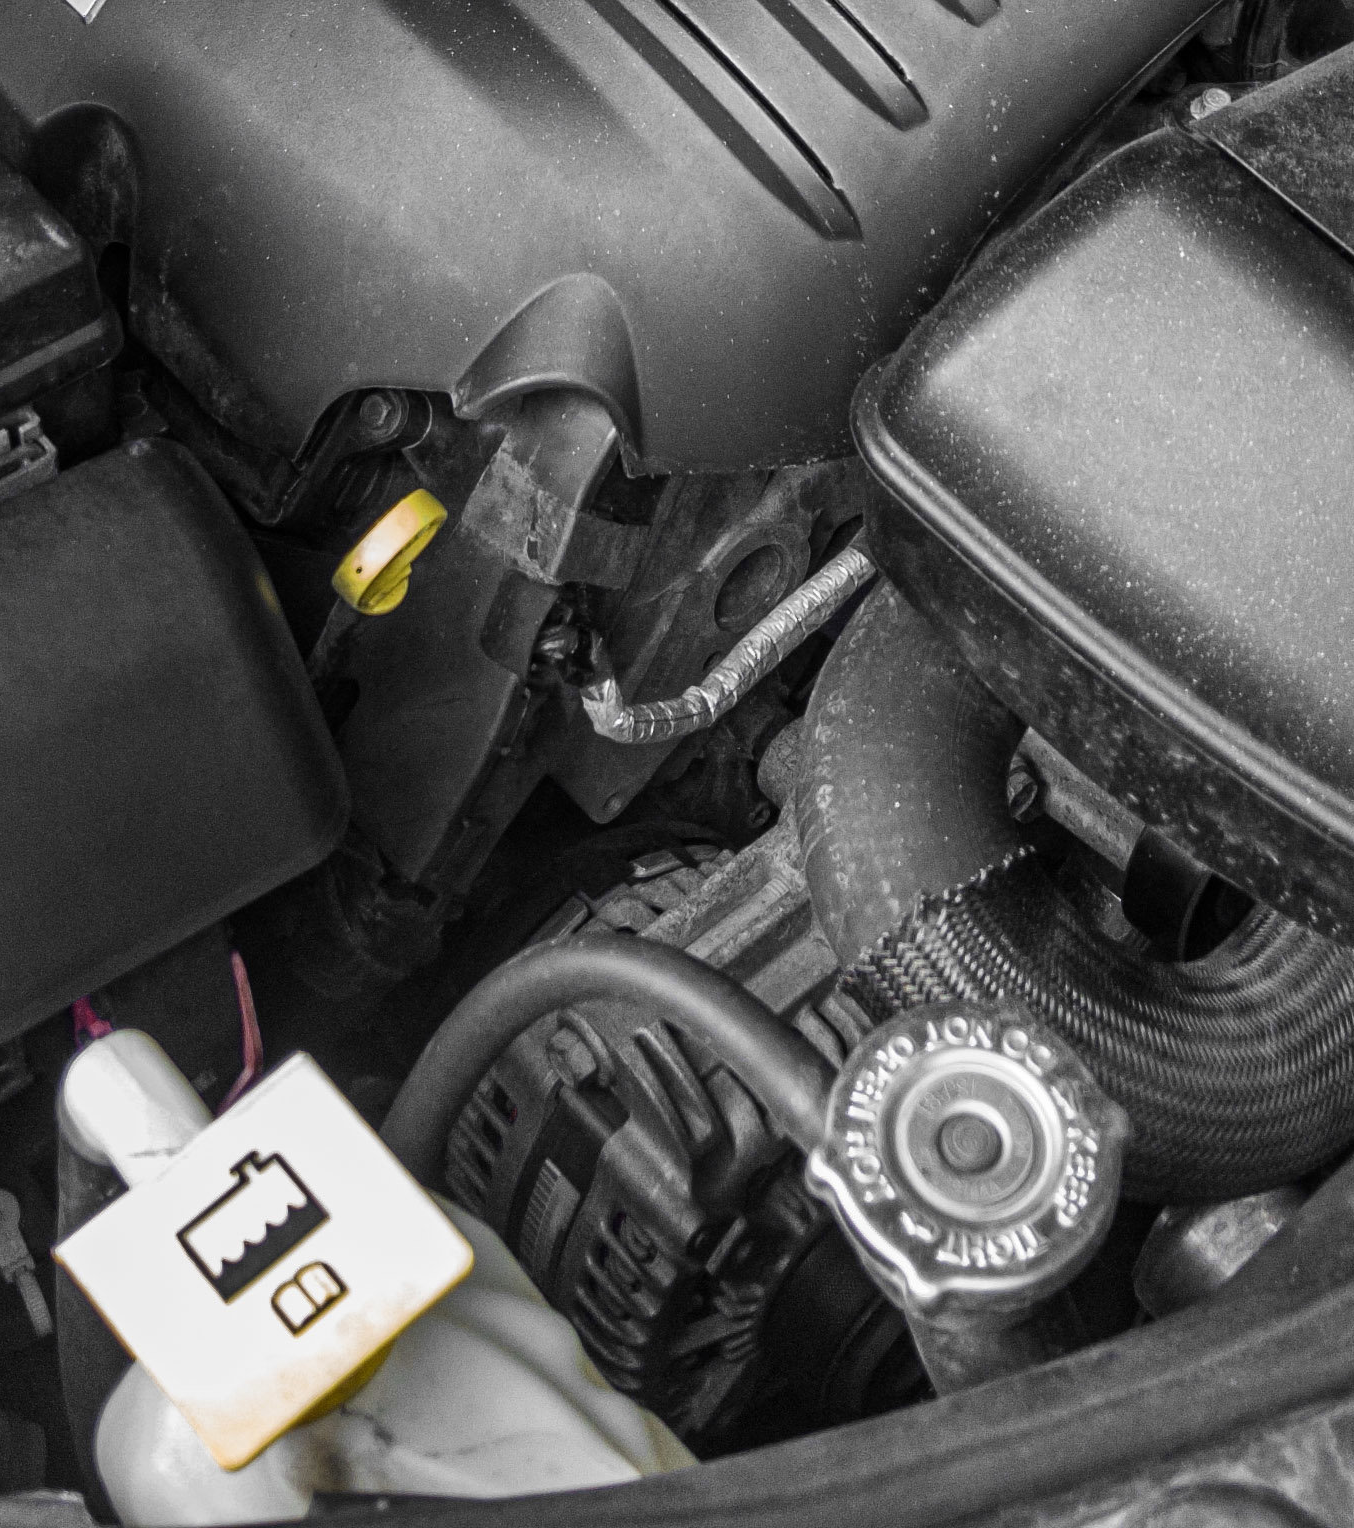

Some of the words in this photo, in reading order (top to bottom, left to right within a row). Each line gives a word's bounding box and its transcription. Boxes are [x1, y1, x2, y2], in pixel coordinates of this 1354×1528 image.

[925, 1016, 992, 1052] NOT
[1002, 1029, 1055, 1076] DO
[936, 1224, 1047, 1267] TIGHT
